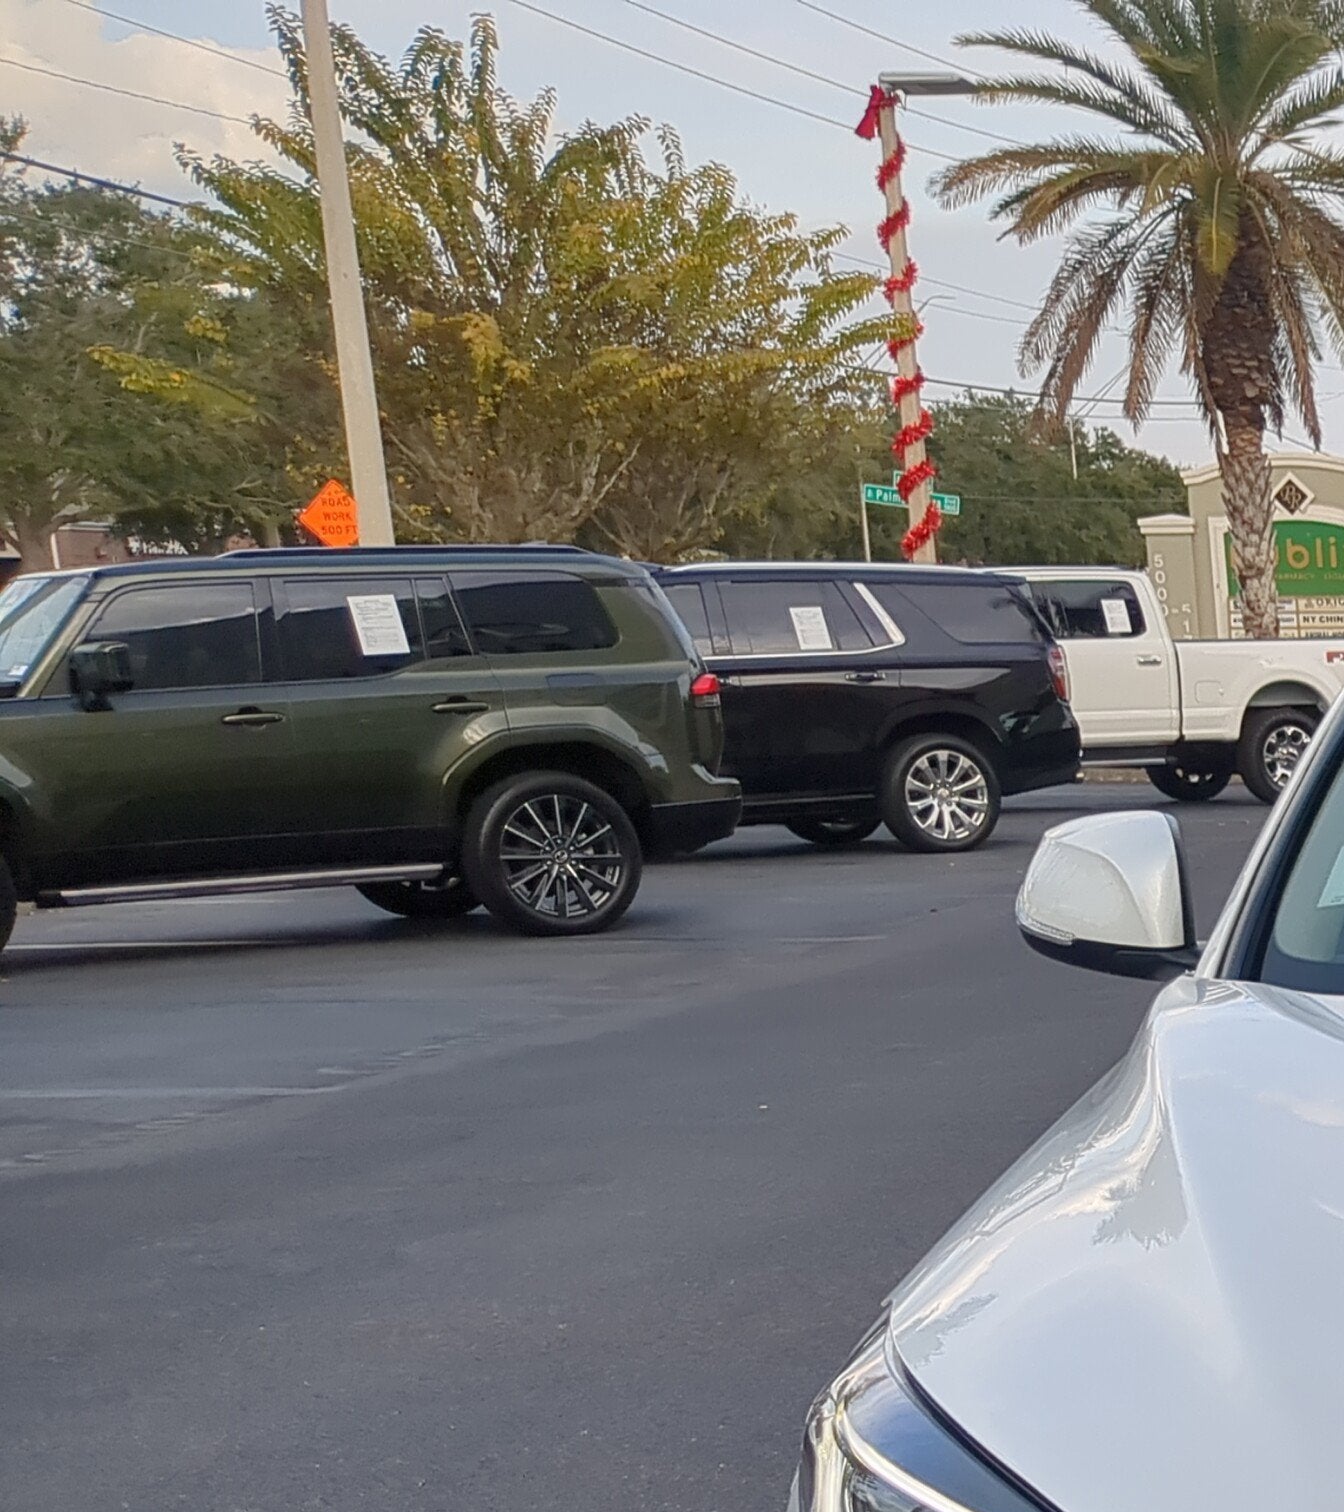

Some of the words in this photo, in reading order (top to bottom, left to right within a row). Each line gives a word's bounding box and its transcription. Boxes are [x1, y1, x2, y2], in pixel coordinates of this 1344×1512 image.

[321, 497, 351, 507] ROAD
[322, 512, 353, 521] WORK
[321, 525, 343, 535] 500
[345, 525, 358, 535] FT
[1302, 615, 1317, 624] NY
